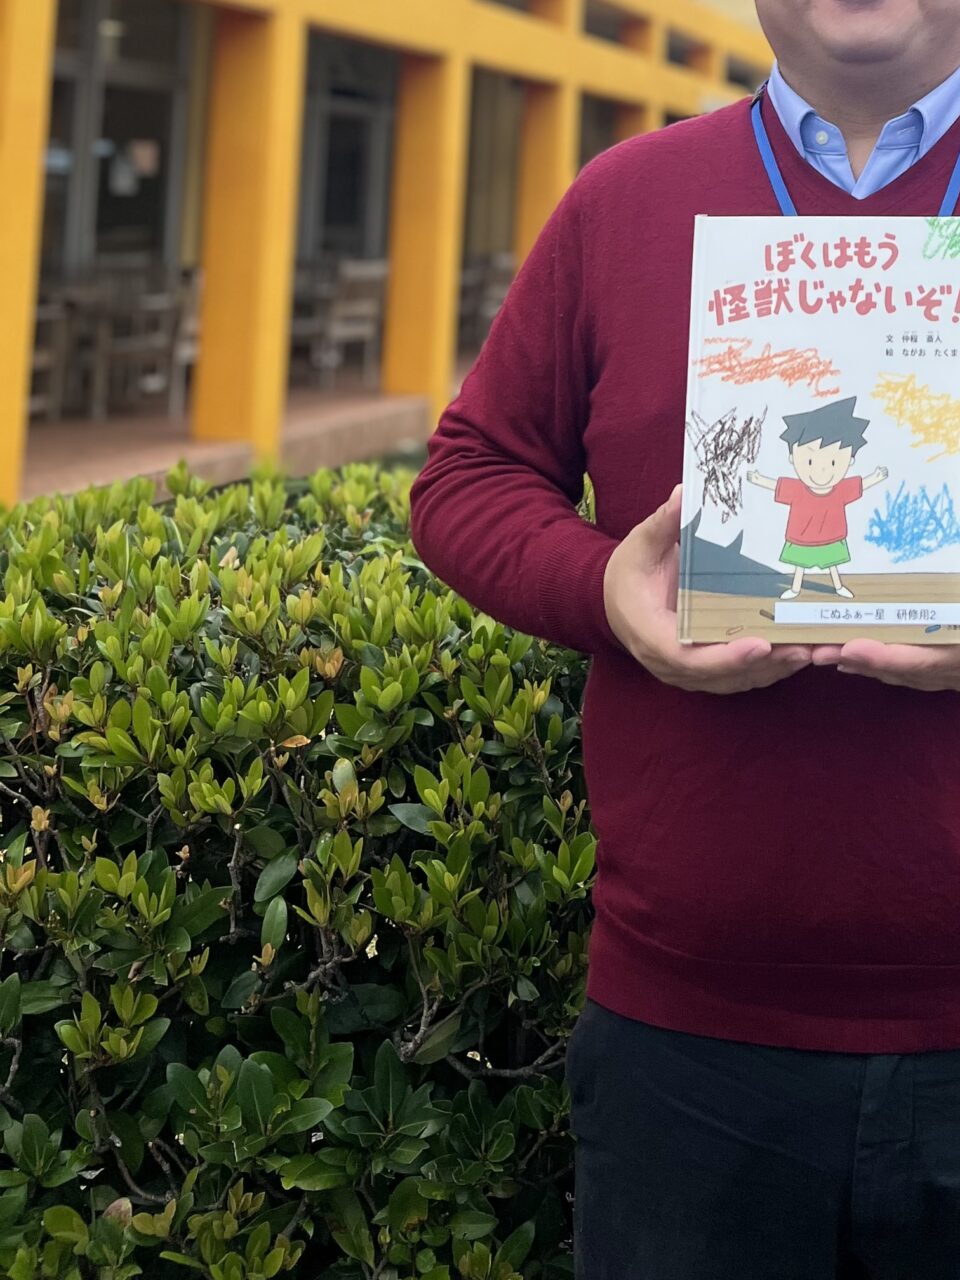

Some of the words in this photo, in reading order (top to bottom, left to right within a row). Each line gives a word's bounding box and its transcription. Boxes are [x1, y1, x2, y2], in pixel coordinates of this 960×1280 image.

[764, 233, 899, 273] ぼくはもう
[885, 333, 894, 343] 文
[885, 348, 894, 357] 絵
[902, 348, 926, 357] ながお
[934, 348, 958, 357] たくま
[820, 608, 885, 620] にぬふぁー星
[896, 608, 937, 620] 研修用2
